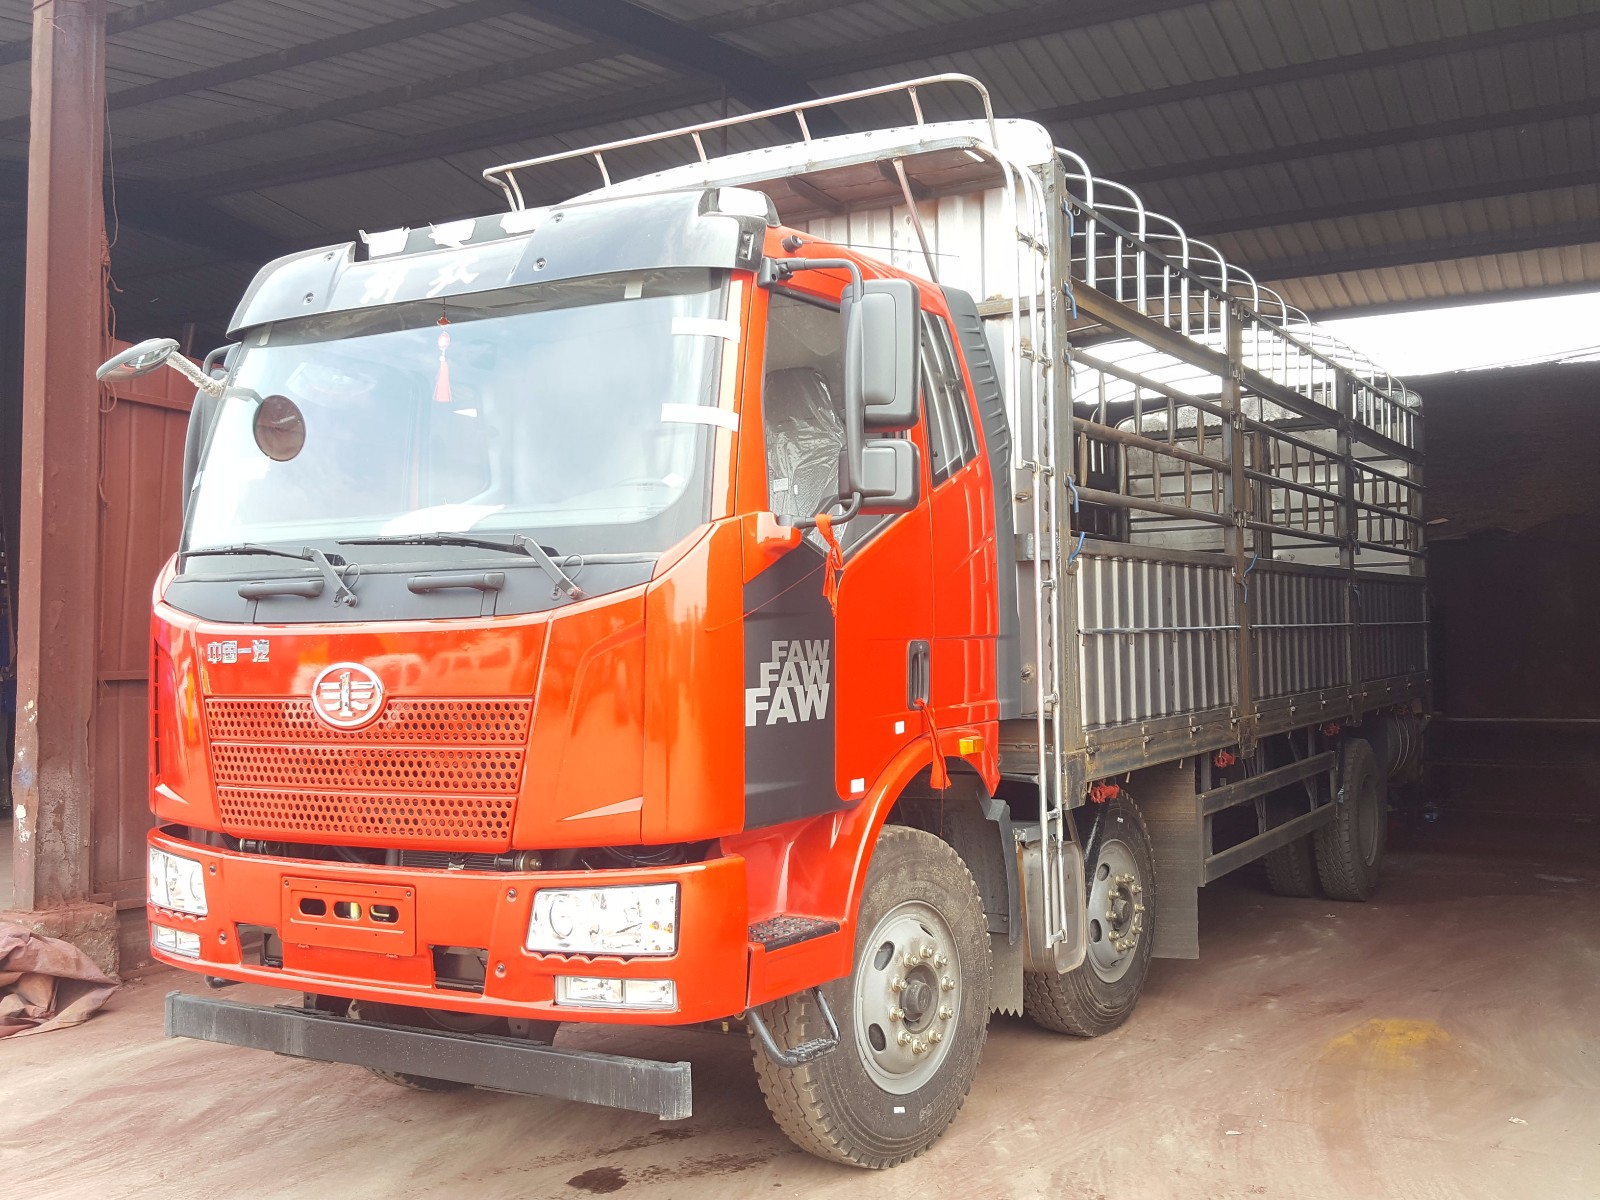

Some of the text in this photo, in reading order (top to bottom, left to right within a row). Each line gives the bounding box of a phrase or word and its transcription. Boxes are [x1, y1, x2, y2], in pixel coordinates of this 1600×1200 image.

[207, 639, 270, 664] 中国一汽
[771, 639, 830, 665] FAW
[760, 660, 830, 691] FAW
[745, 683, 830, 727] FAW
